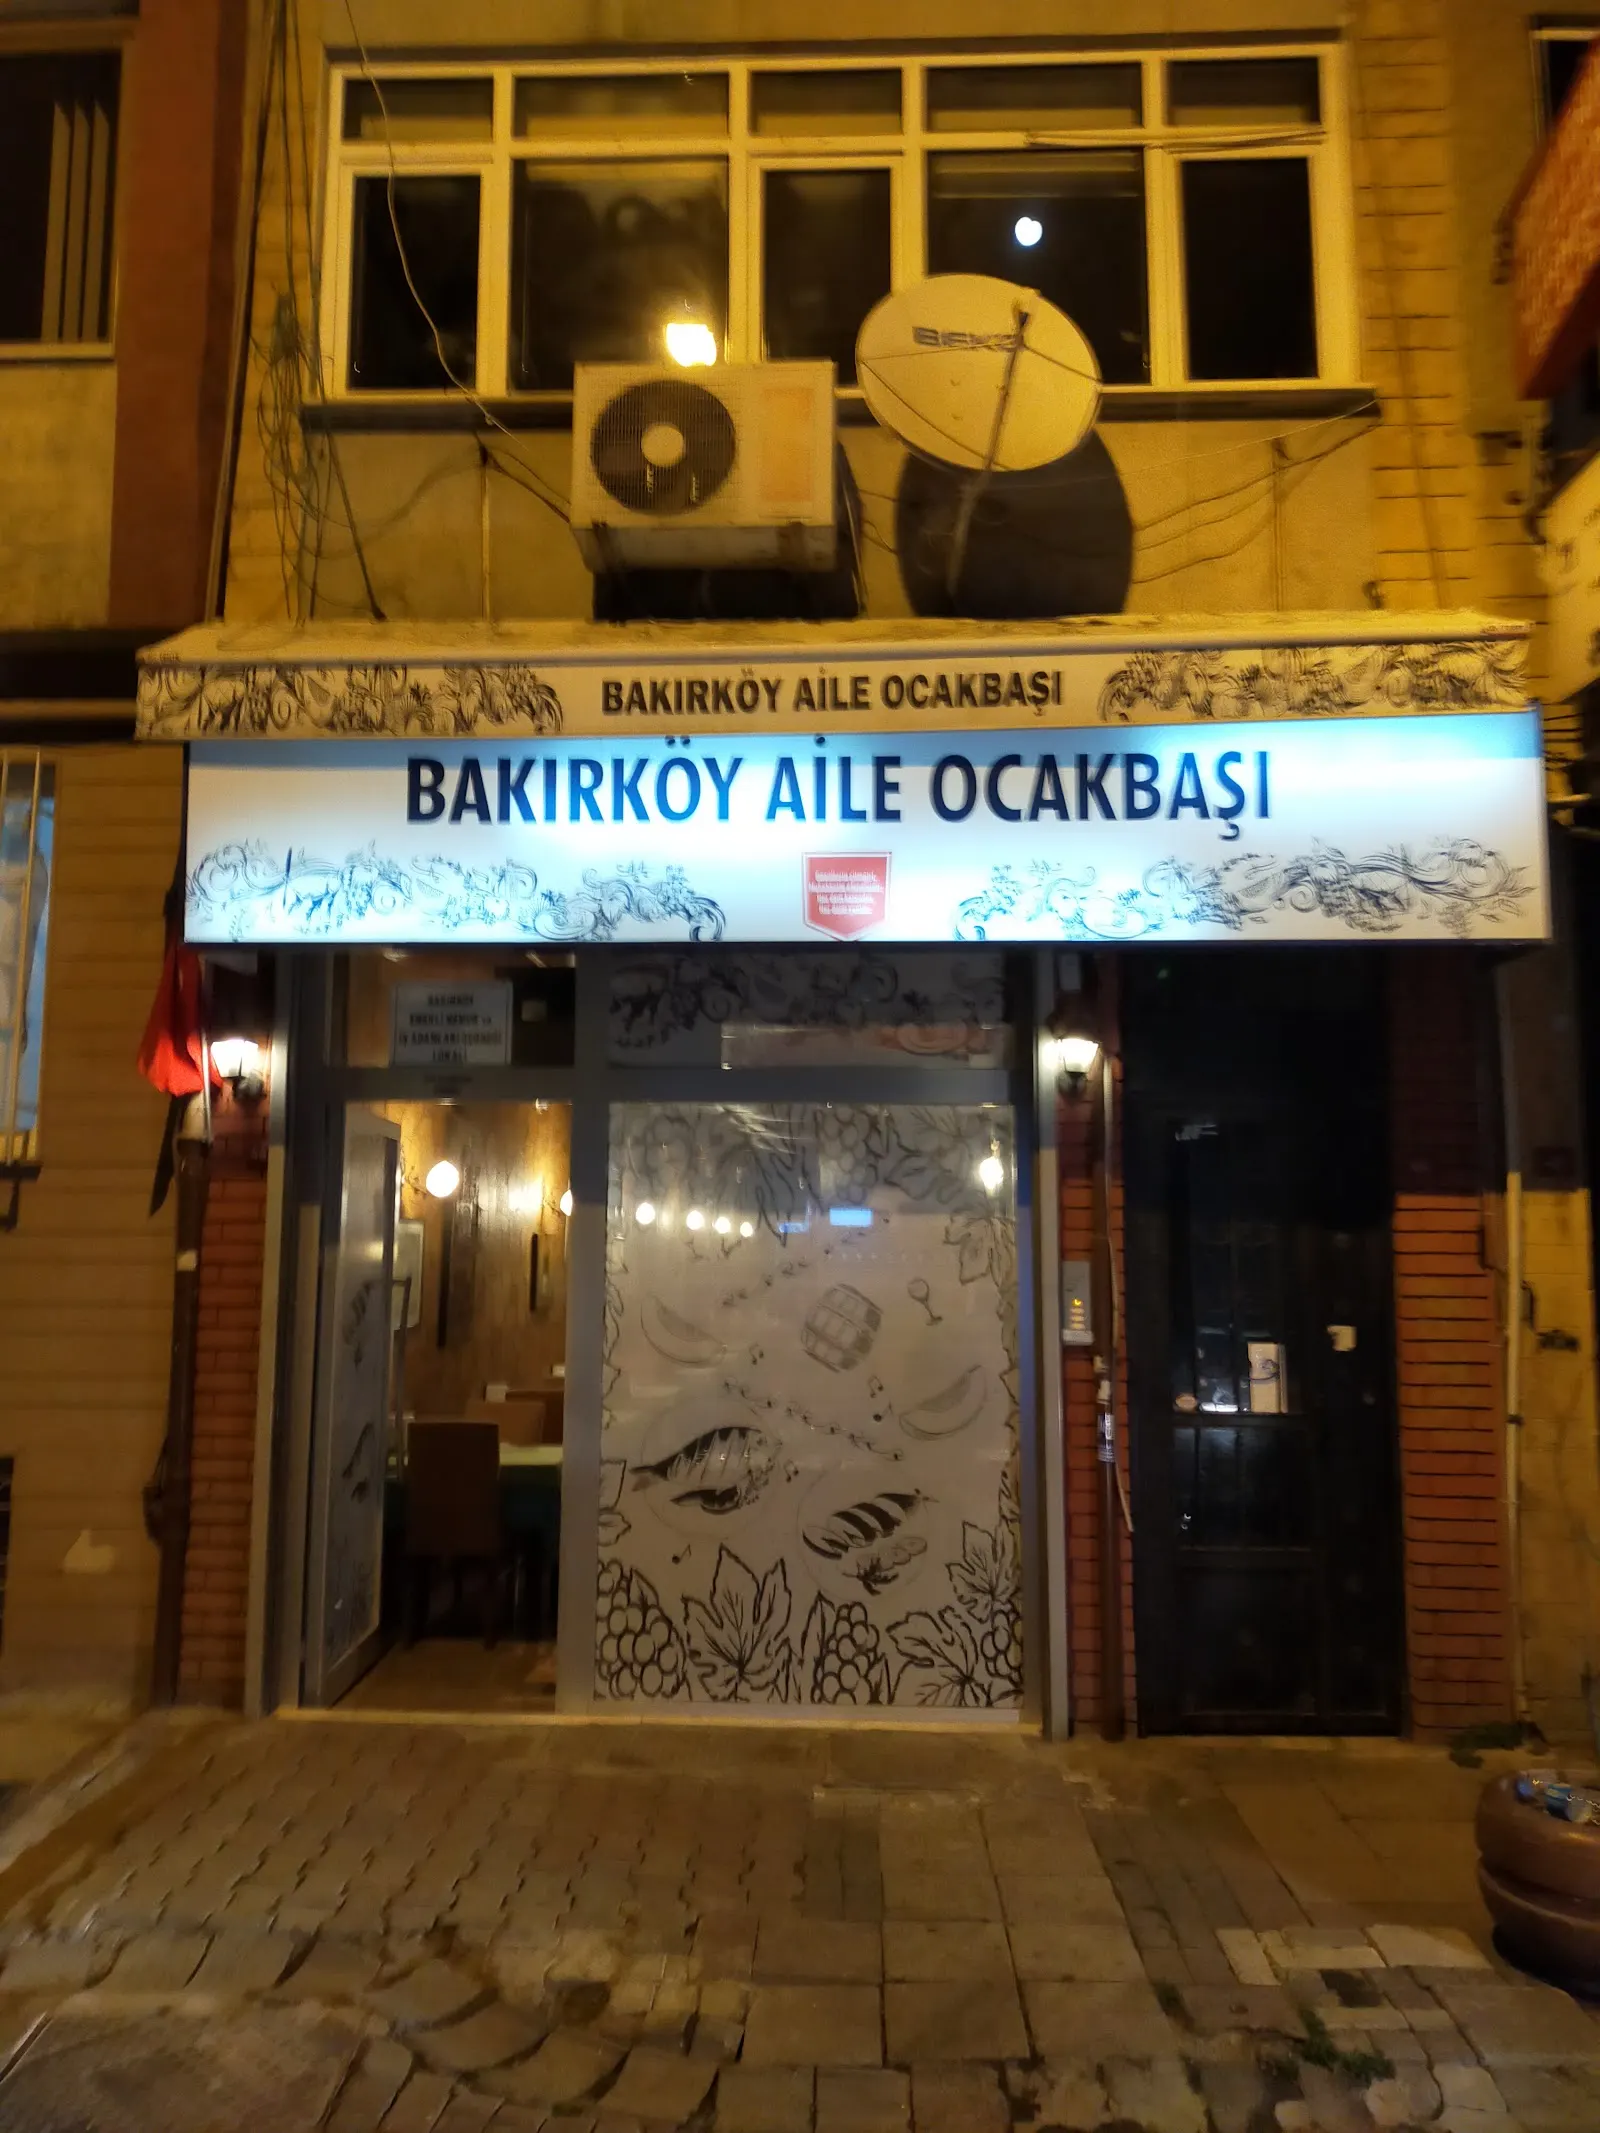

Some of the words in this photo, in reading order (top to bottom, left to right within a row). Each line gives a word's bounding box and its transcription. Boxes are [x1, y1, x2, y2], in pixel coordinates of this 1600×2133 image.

[602, 667, 782, 716] BAKIRKÖY
[793, 666, 870, 711] AİLE
[881, 671, 1062, 716] OCAKBAŞI
[406, 734, 744, 825] BAKIRKÖY
[765, 733, 902, 823] AİLE
[930, 750, 1271, 841] OCAKBAŞI
